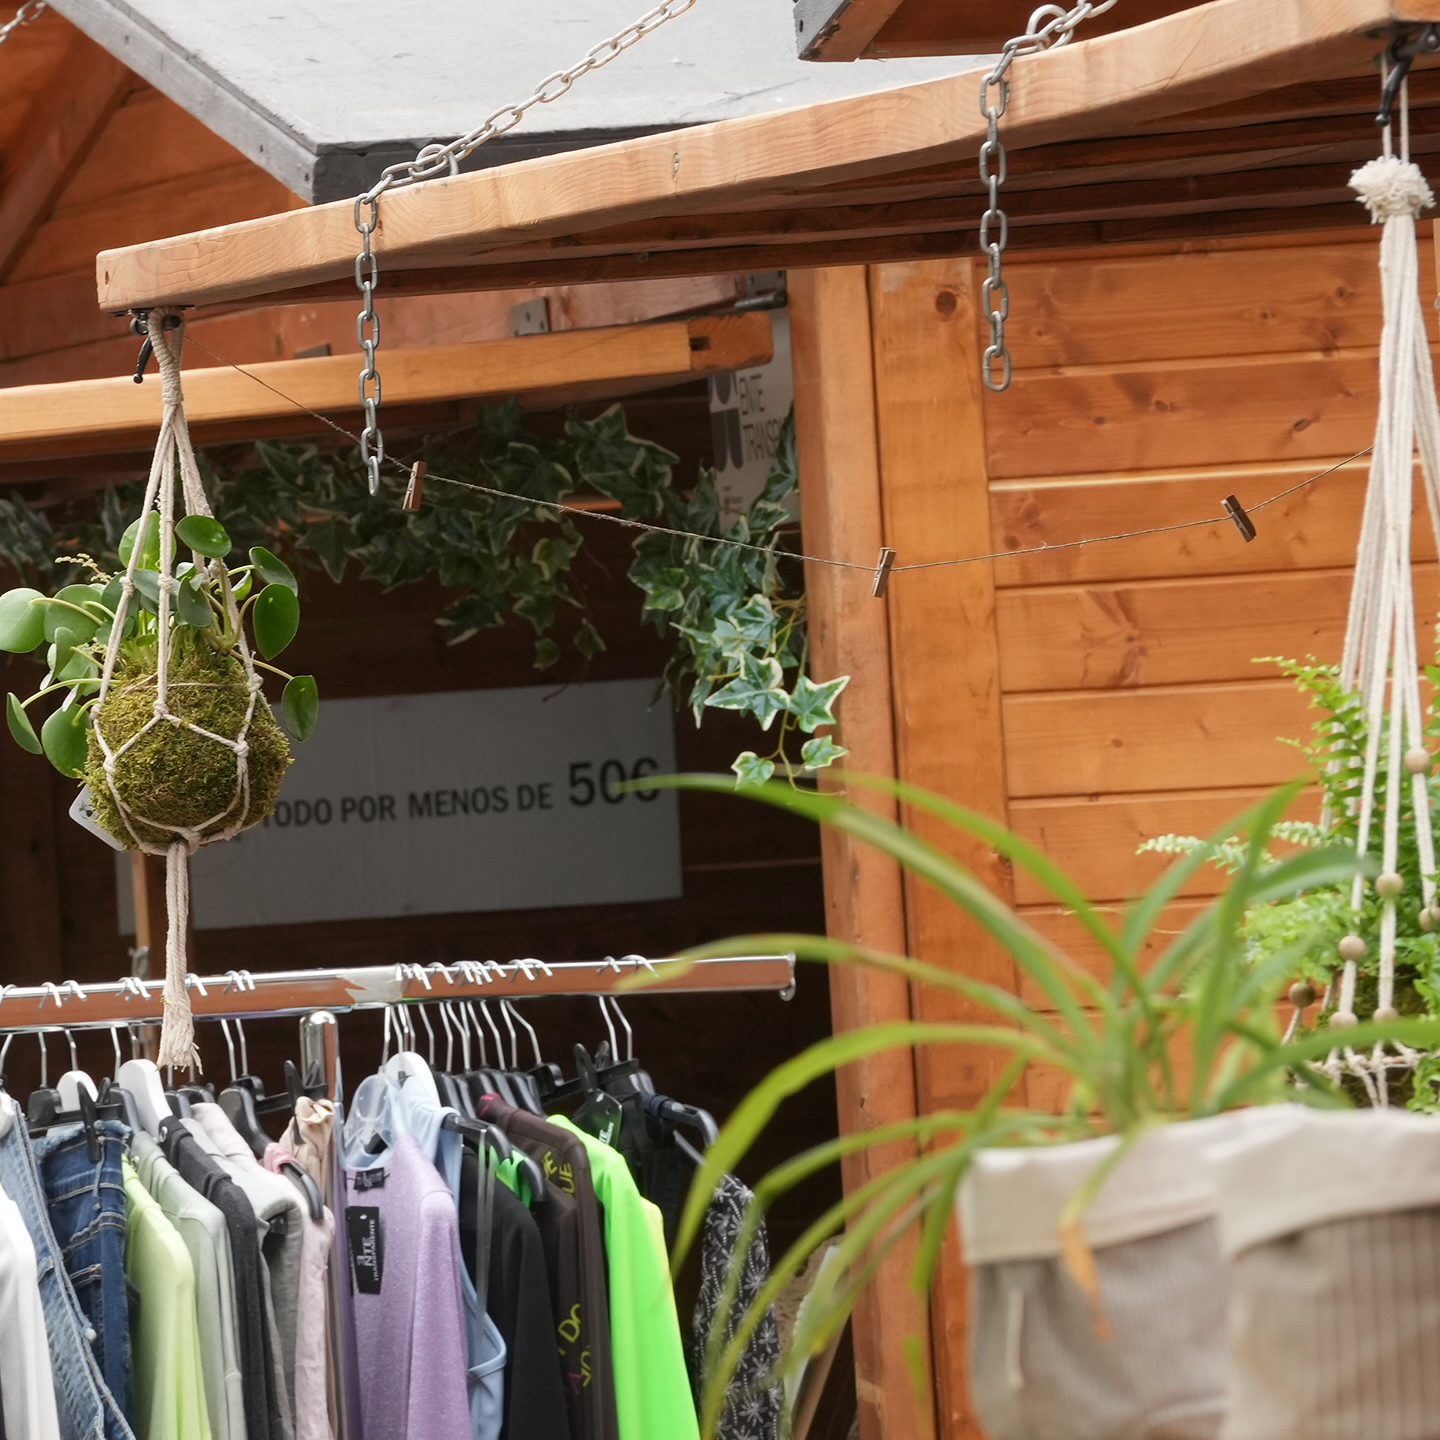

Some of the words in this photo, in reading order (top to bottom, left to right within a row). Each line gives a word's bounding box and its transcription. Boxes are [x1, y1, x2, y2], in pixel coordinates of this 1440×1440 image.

[341, 794, 397, 823] POR
[408, 784, 510, 818] MENOS
[517, 782, 553, 812] DE
